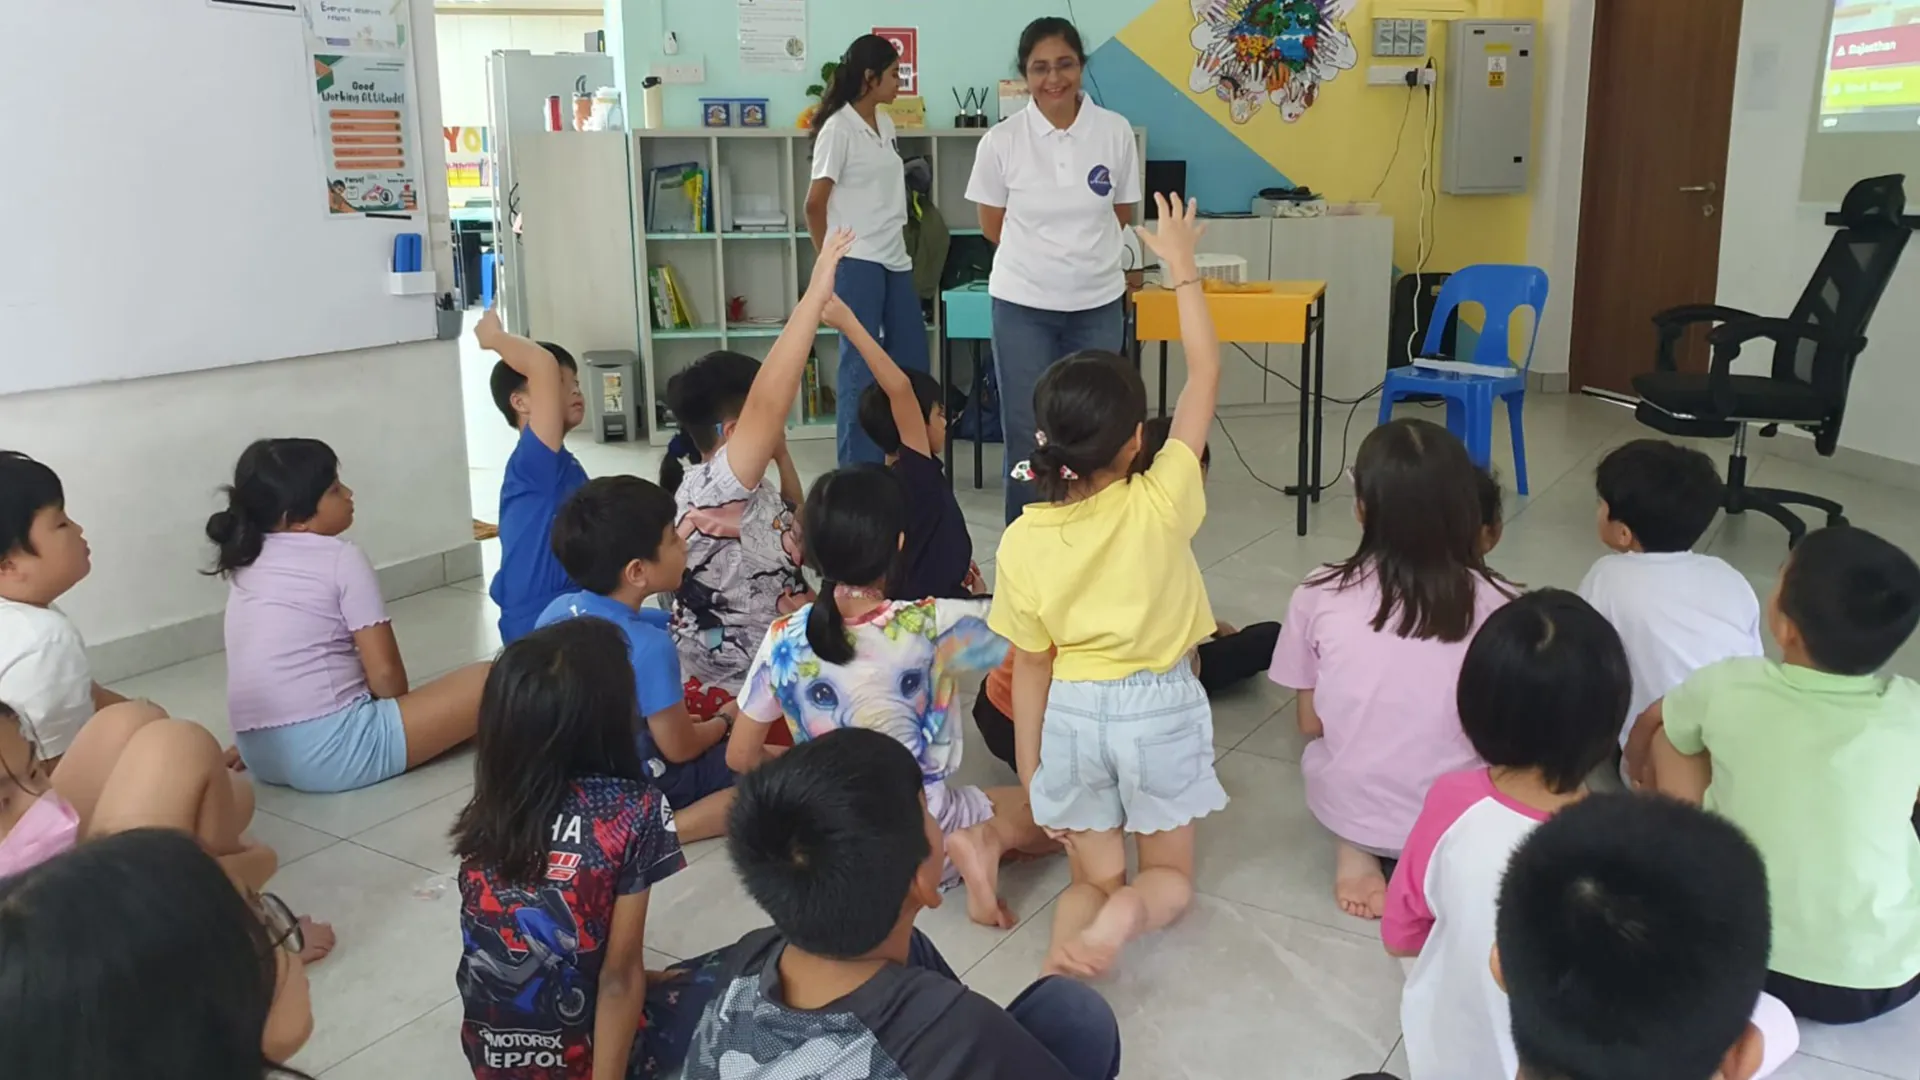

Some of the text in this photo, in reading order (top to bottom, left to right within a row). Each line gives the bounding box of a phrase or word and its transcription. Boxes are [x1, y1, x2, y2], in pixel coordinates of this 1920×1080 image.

[320, 1, 351, 13] Everyone
[352, 81, 375, 90] Good
[322, 91, 359, 104] Working
